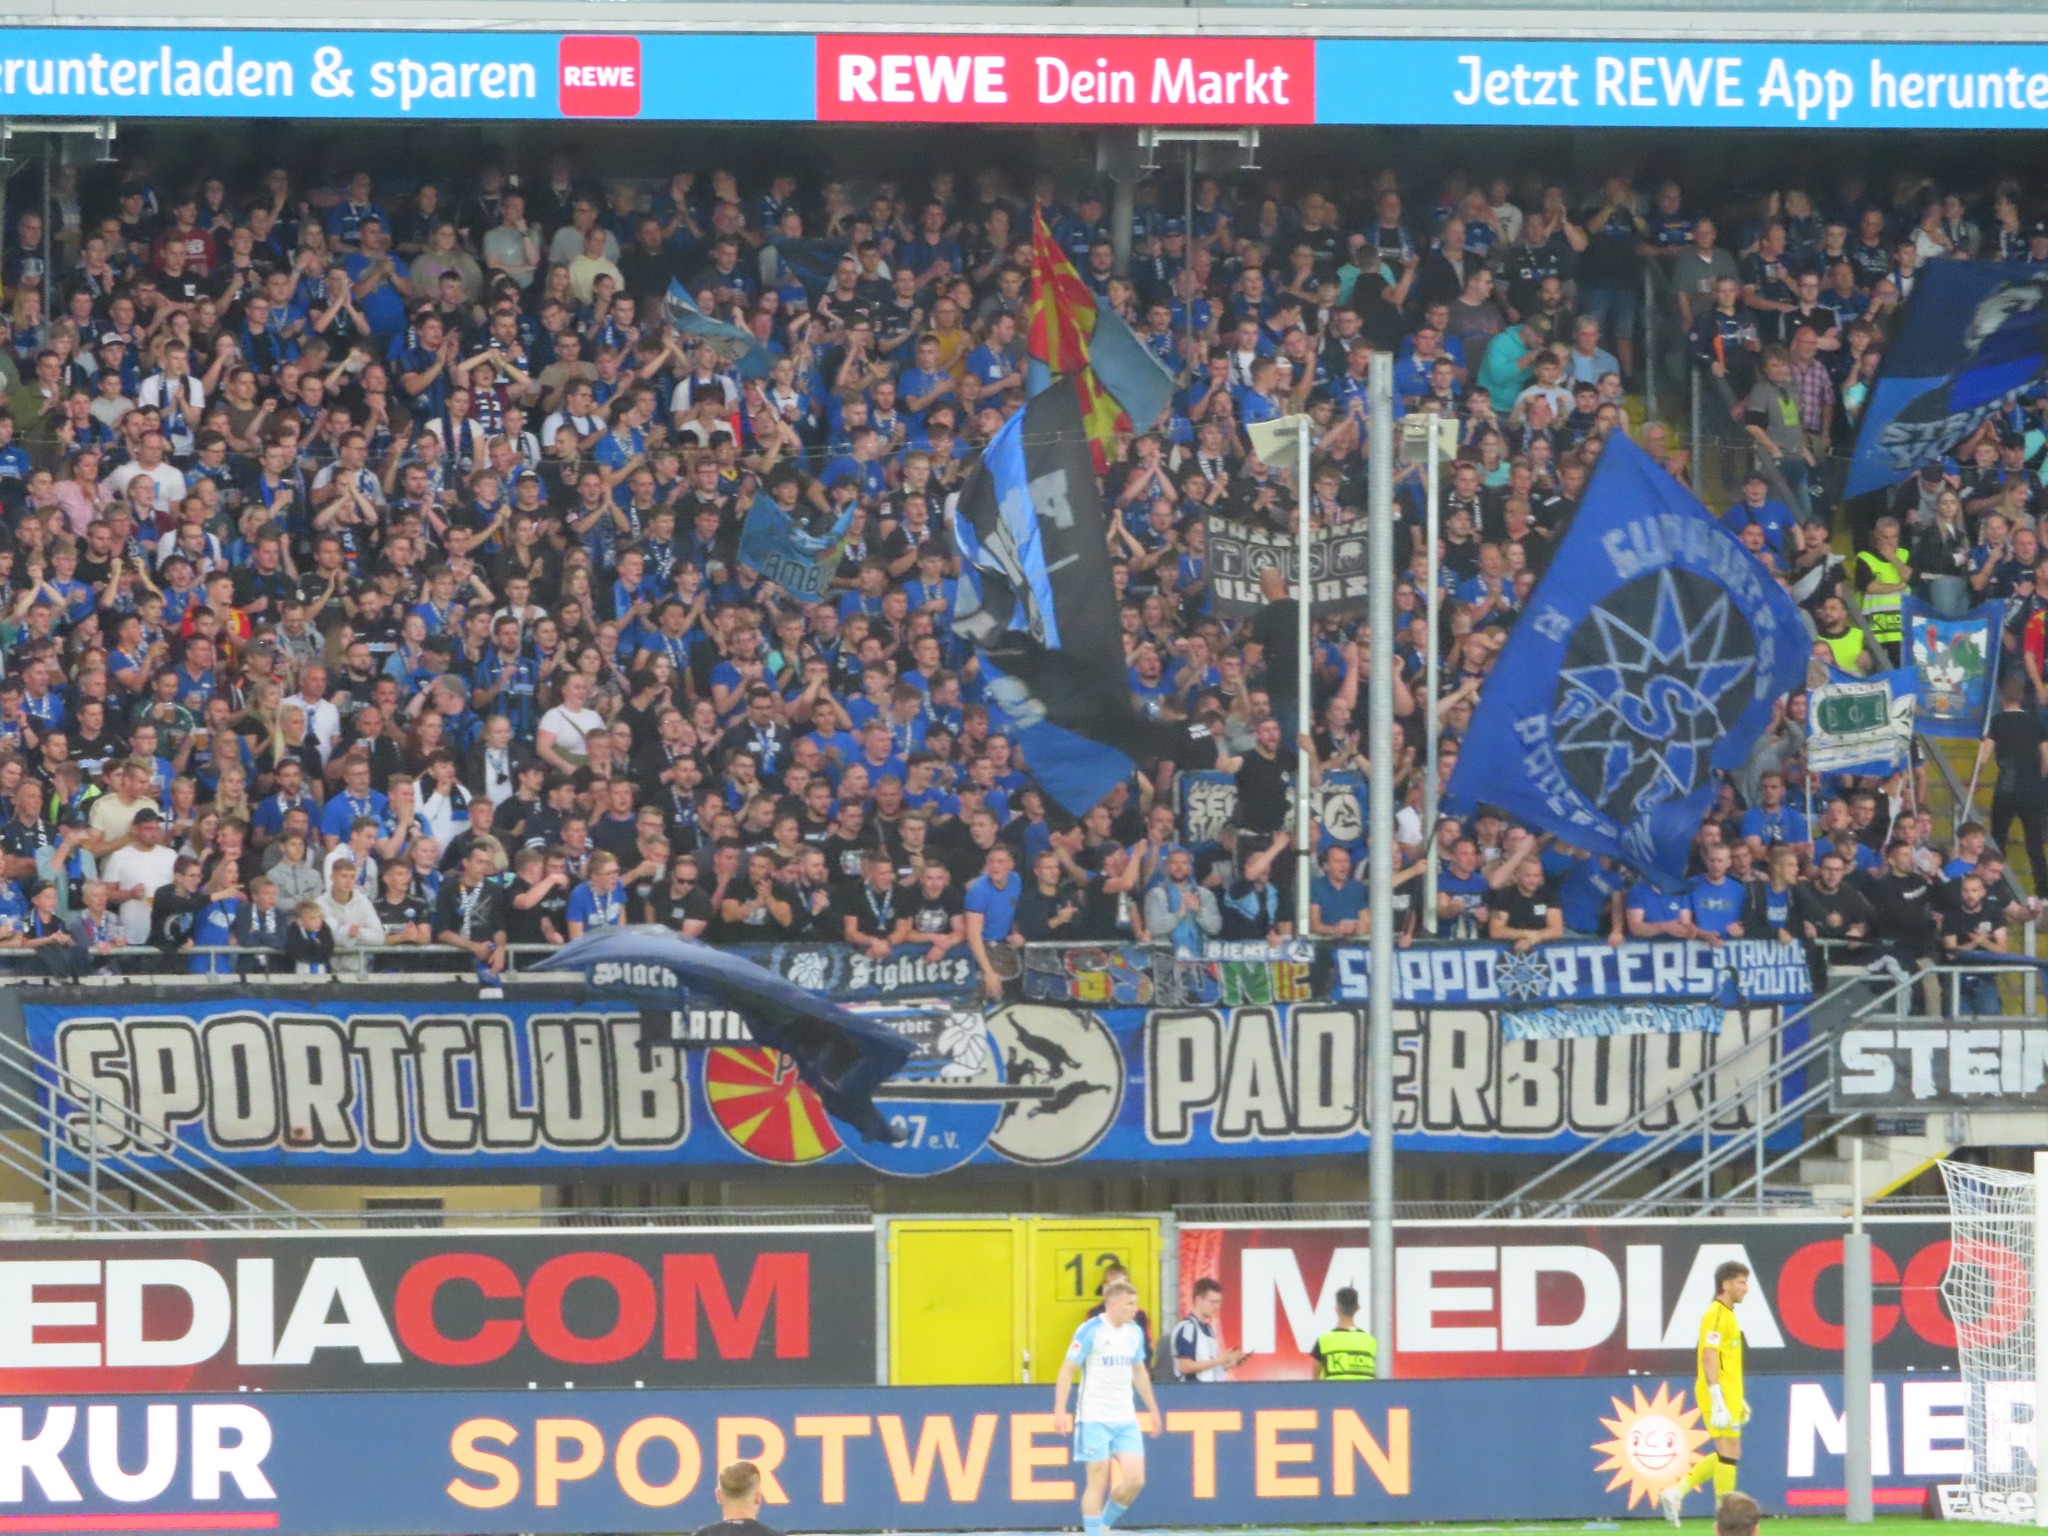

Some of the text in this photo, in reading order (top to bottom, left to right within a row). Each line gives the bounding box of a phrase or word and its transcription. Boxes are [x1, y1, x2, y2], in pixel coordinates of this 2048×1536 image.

[0, 46, 536, 110] runterladen & sparen
[564, 66, 635, 87] REWE
[839, 54, 1290, 105] REWE Dein Markt
[1453, 56, 2048, 121] Jetzt REWE App herunte
[55, 1011, 692, 1157] SPORTCLUB
[0, 1252, 810, 1367] EDIACOM
[446, 1407, 1411, 1509] SPORTWETEN
